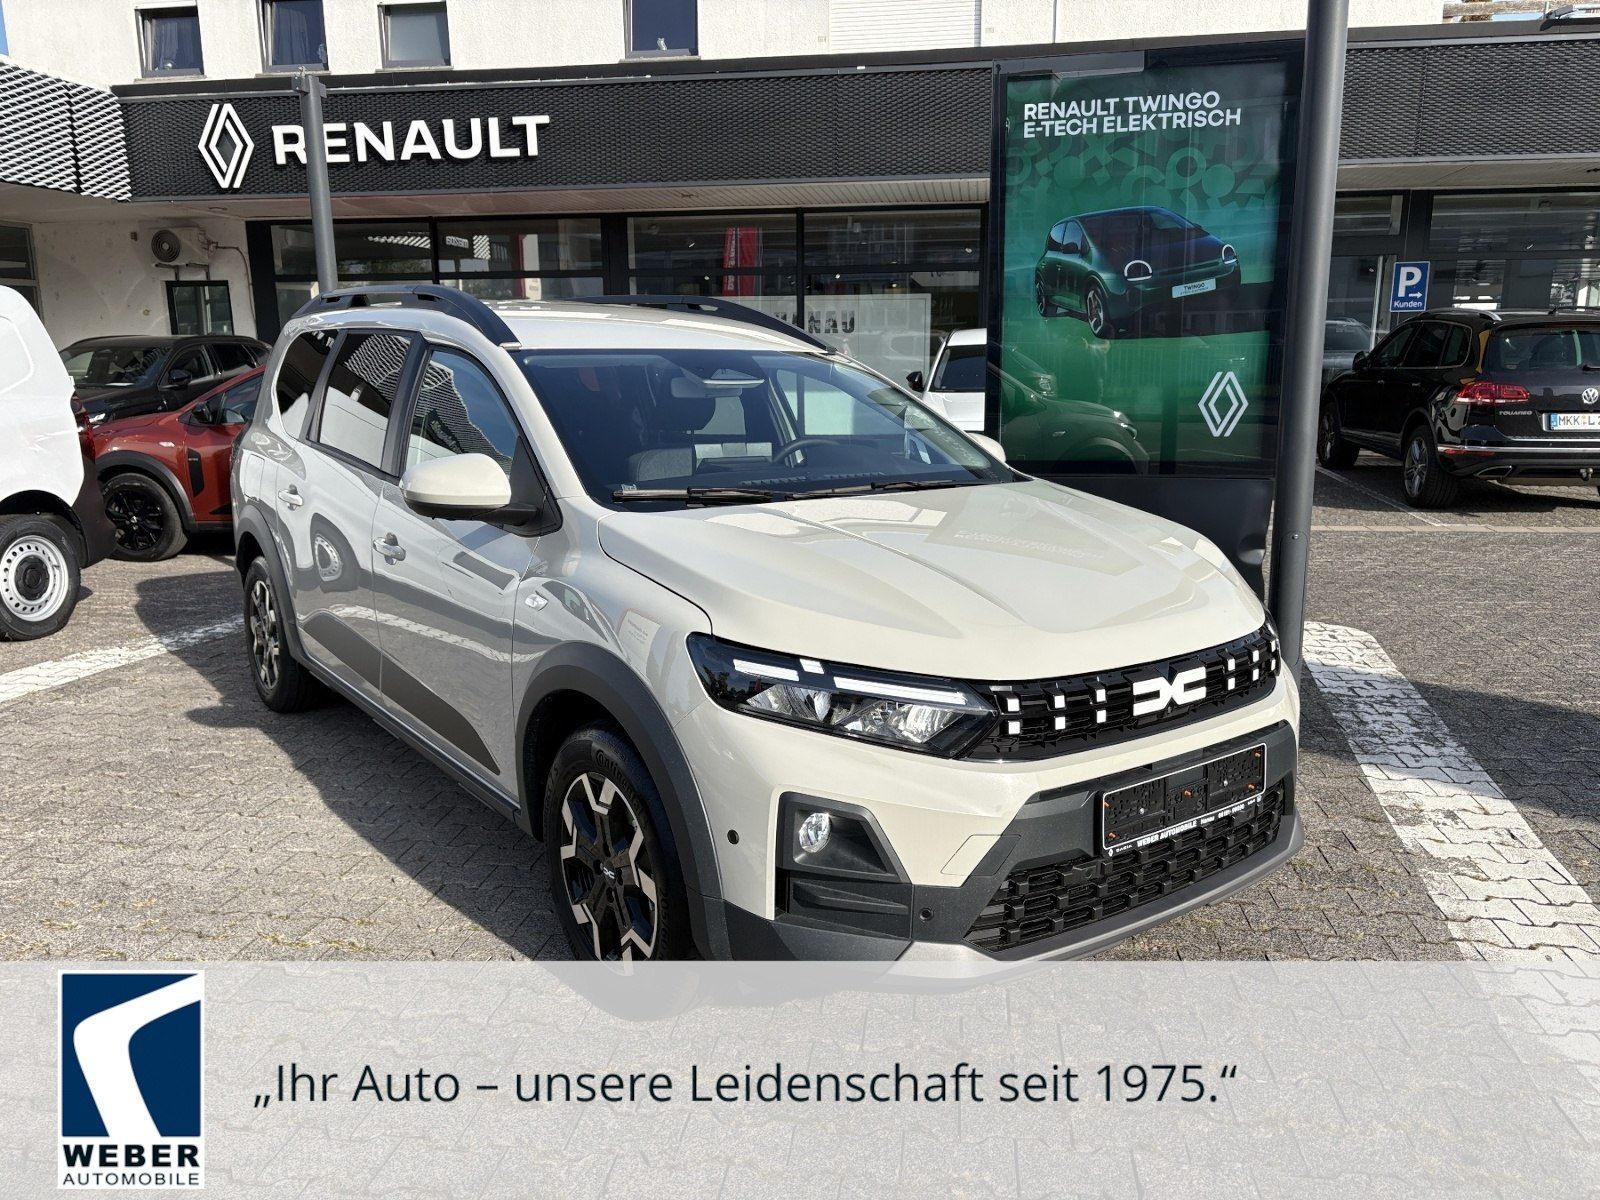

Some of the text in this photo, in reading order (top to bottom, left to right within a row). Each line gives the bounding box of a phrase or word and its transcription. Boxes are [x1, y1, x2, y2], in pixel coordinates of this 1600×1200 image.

[1024, 91, 1220, 120] RENAULT TWINGO
[1024, 108, 1242, 138] E-TECH ELEKTRISCH
[271, 115, 550, 165] RENAULT
[1183, 282, 1206, 291] TWINGO
[1397, 266, 1422, 297] P
[1393, 300, 1423, 308] Kunden
[1558, 416, 1580, 426] MKK
[1136, 833, 1160, 847] WEBER
[1160, 819, 1198, 840] AUTOMOBILE
